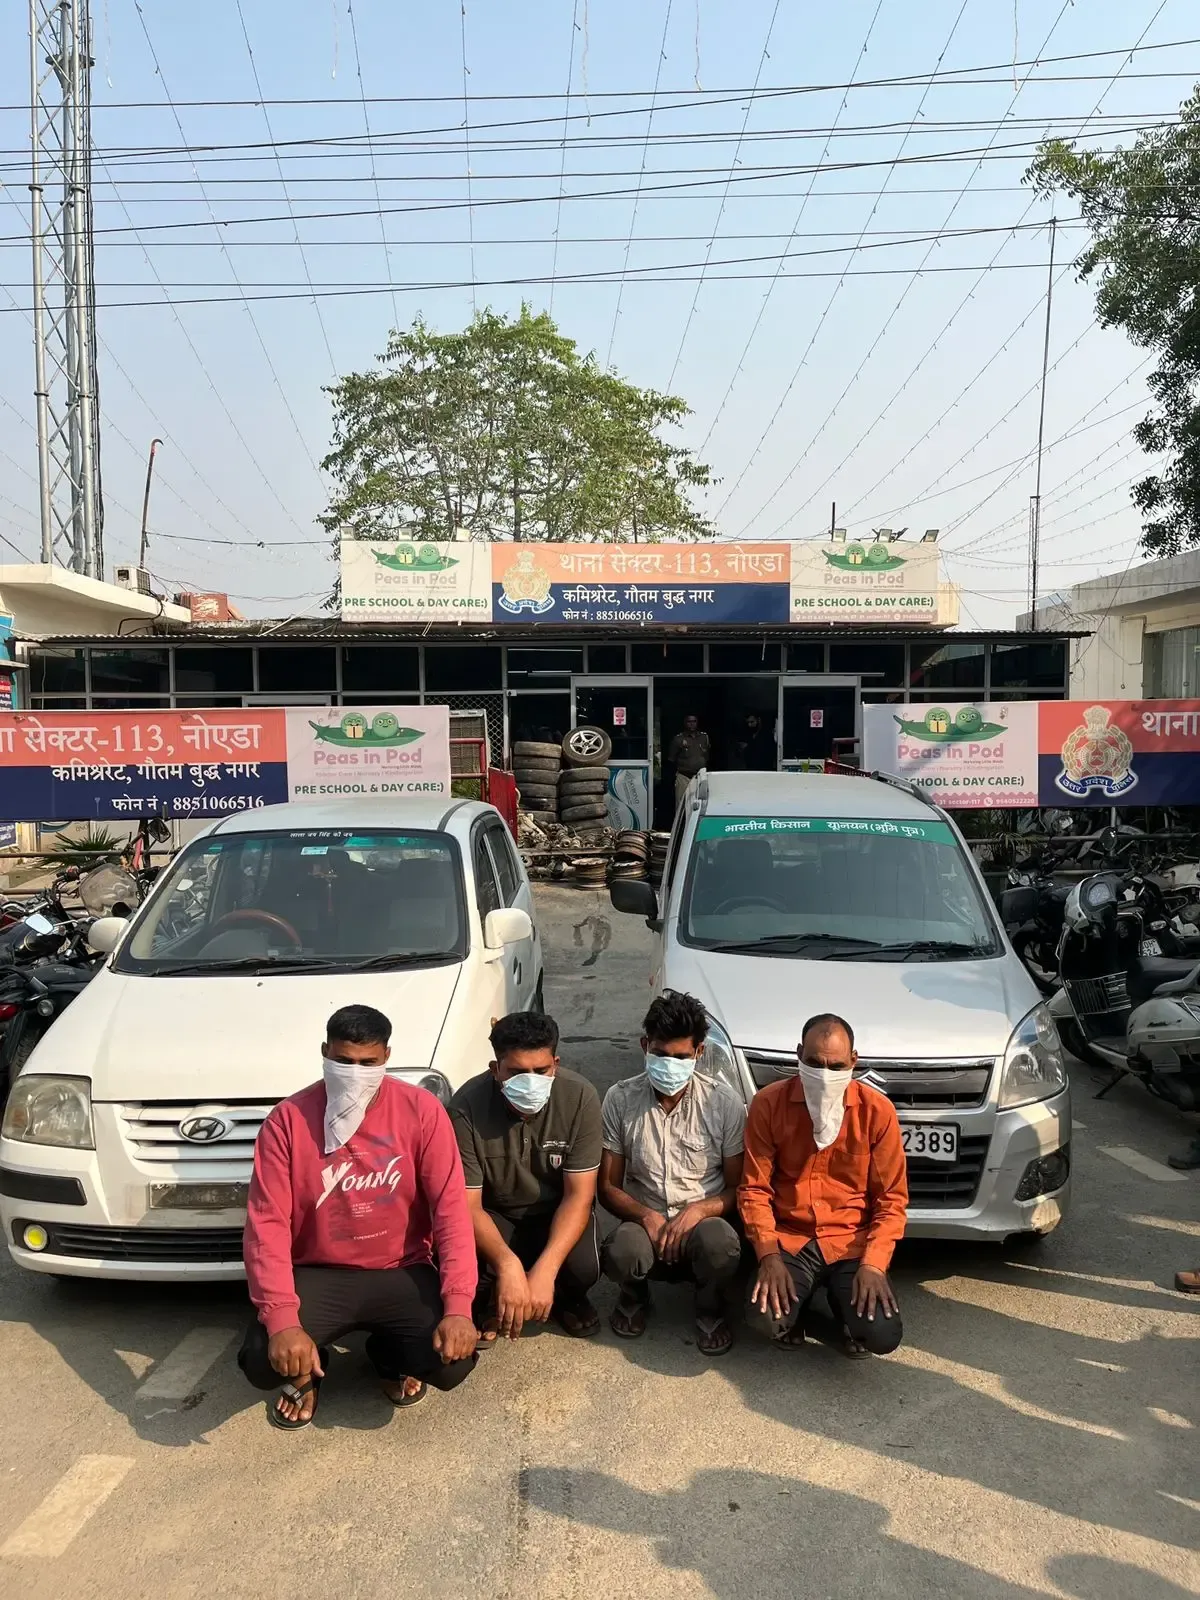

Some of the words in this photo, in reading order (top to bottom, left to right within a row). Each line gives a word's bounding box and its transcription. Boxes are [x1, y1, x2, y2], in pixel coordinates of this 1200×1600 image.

[560, 552, 605, 574] थाना
[610, 546, 719, 578] सेक्टर-113,
[726, 545, 786, 577] नोएडा
[374, 572, 408, 585] Peas
[412, 572, 426, 585] in
[430, 572, 457, 585] Pod
[824, 572, 857, 585] Peas
[861, 572, 874, 584] in
[878, 572, 904, 584] Pod
[344, 598, 366, 607] PRE
[368, 598, 414, 607] SCHOOL
[416, 598, 425, 607] &
[428, 598, 450, 607] DAY
[452, 598, 488, 608] CARE:)
[624, 584, 660, 604] गौतम
[661, 589, 686, 609] बुद्ध
[688, 589, 714, 604] नगर
[794, 598, 814, 607] PRE
[818, 598, 862, 607] SCHOOL
[864, 598, 872, 606] &
[875, 598, 897, 606] DAY
[899, 597, 934, 608] CARE:)
[562, 608, 580, 620] फोन
[581, 608, 589, 620] नं
[596, 610, 653, 620] 8851066516
[1142, 712, 1200, 736] थाना
[21, 716, 174, 757] सेक्टर-113,
[181, 714, 263, 754] नोएडा
[314, 750, 359, 765] Peas
[364, 749, 380, 764] in
[386, 748, 422, 764] Pod
[898, 744, 941, 760] Peas
[946, 744, 963, 758] in
[968, 743, 1004, 758] Pod
[136, 756, 184, 780] गौतम
[187, 762, 222, 787] बुद्ध
[222, 761, 261, 780] नगर
[294, 786, 317, 794] PRE
[320, 784, 368, 794] SCHOOL
[370, 784, 378, 793] &
[382, 784, 404, 792] DAY
[407, 782, 444, 792] CARE:)
[952, 778, 960, 786] &
[963, 778, 985, 786] DAY
[988, 776, 1024, 786] CARE:)
[112, 794, 143, 811] फोन
[146, 794, 157, 811] नं
[172, 795, 265, 811] 8851066516
[724, 821, 767, 832] भारतीय
[771, 820, 811, 830] किसान
[902, 1131, 955, 1154] 2389
